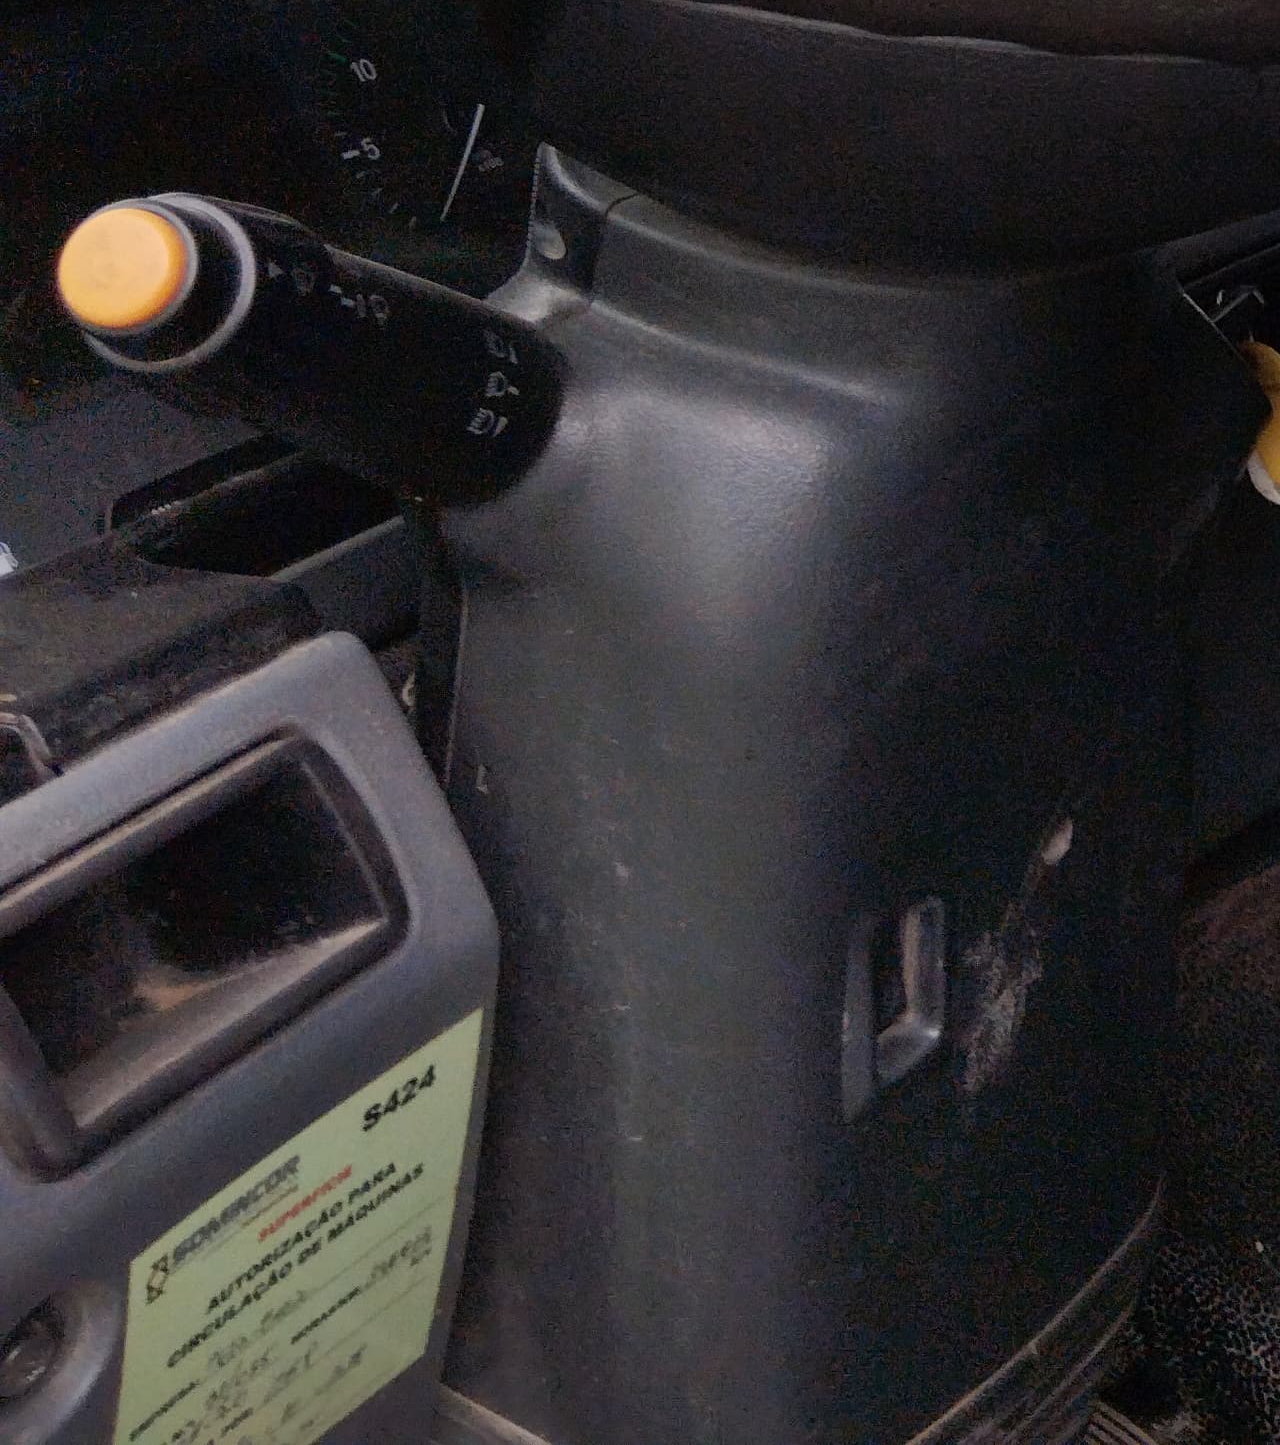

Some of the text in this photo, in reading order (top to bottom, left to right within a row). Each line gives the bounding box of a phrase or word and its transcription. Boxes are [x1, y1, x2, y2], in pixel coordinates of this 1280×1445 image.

[350, 58, 378, 83] 10
[362, 1064, 436, 1132] S424
[206, 1201, 343, 1316] AUTORIZAÇÃO
[348, 1162, 396, 1205] PARA
[166, 1260, 293, 1369] CIRCULAÇÃO
[298, 1236, 322, 1266] DE
